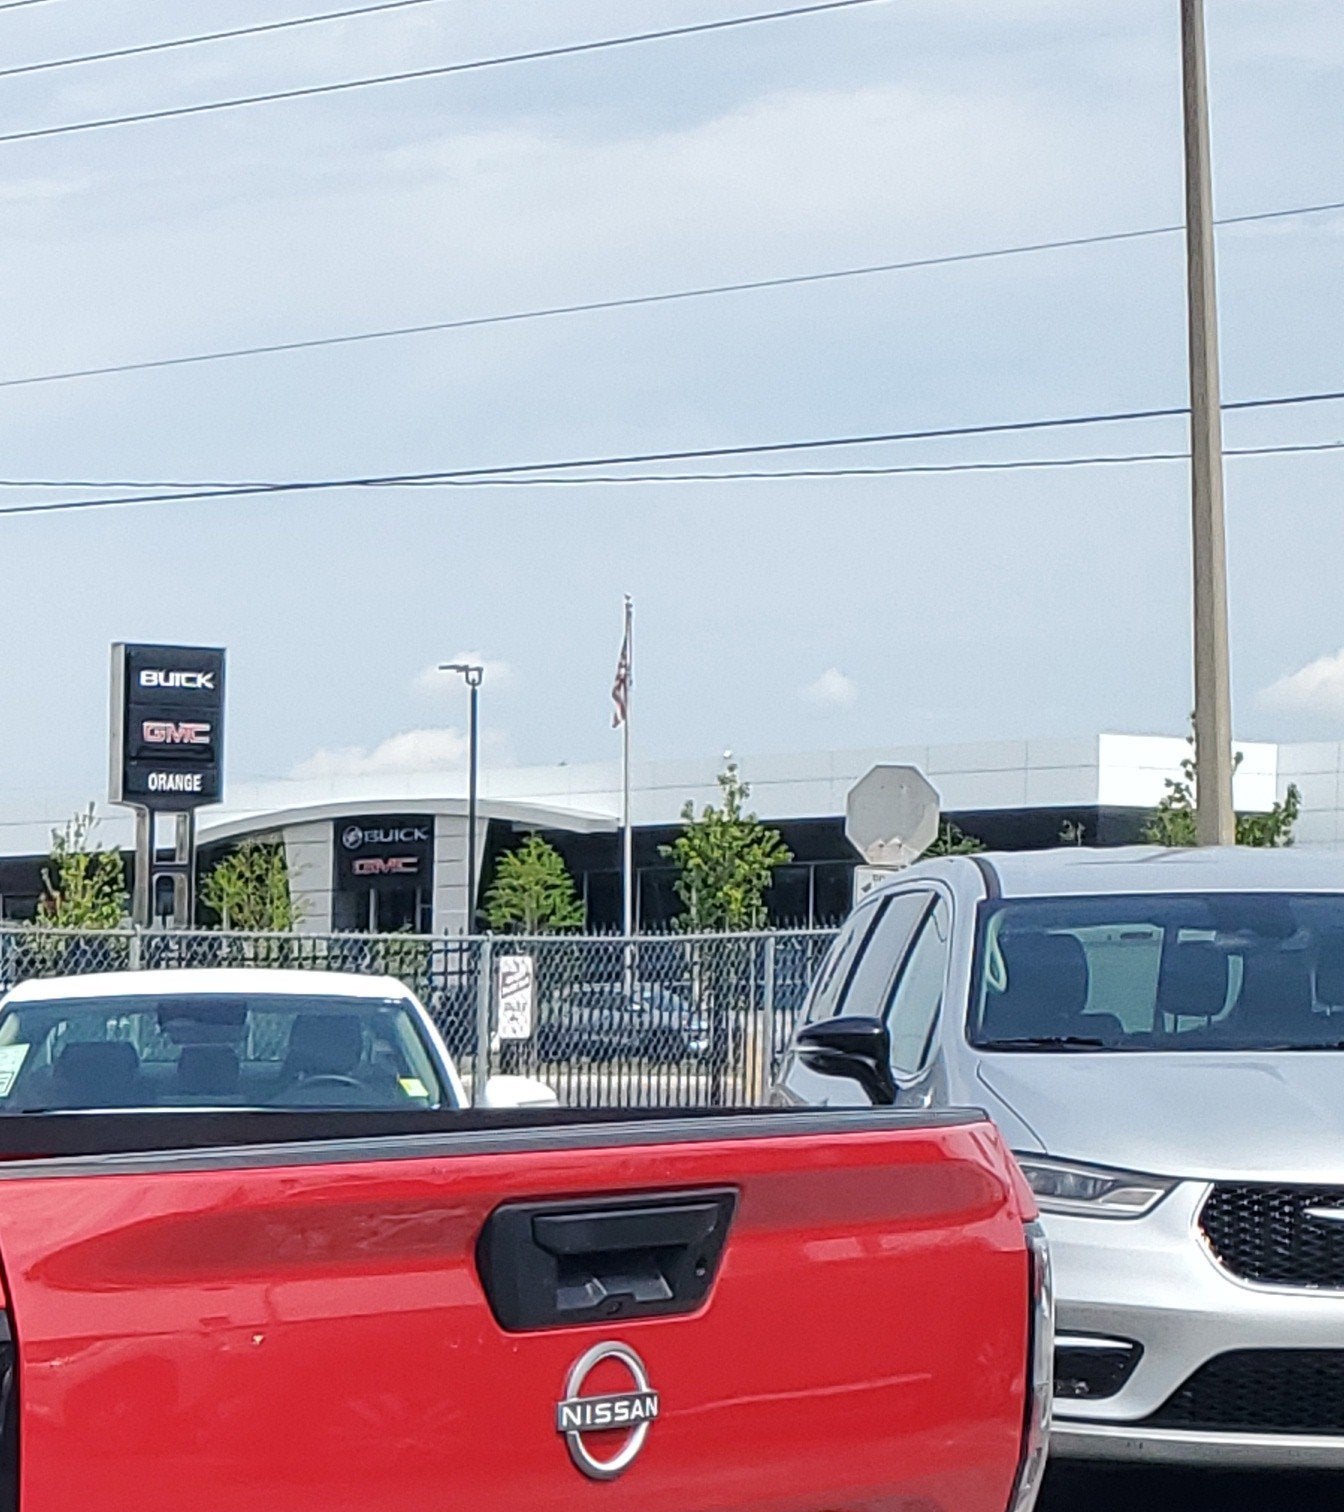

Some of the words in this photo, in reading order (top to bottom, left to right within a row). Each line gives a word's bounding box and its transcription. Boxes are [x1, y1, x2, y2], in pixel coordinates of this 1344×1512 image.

[140, 670, 214, 689] BUICK
[143, 721, 210, 744] GMC
[148, 772, 202, 791] ORANGE
[364, 827, 429, 843] BUICK
[353, 857, 418, 875] GMC
[562, 1395, 658, 1426] NISSAN
